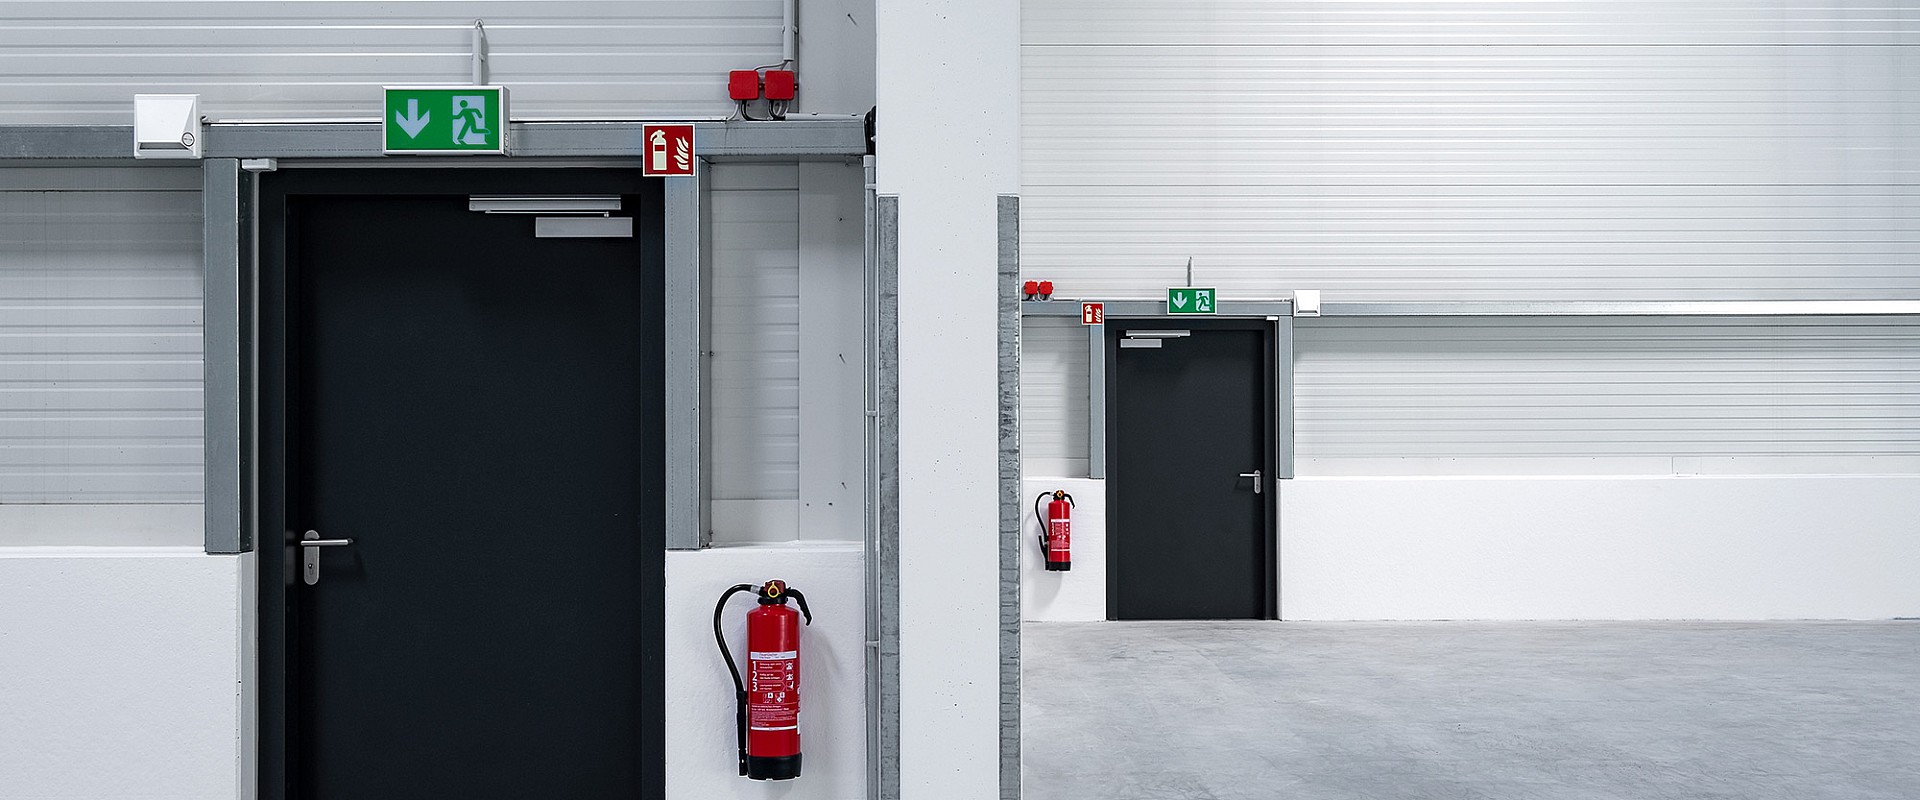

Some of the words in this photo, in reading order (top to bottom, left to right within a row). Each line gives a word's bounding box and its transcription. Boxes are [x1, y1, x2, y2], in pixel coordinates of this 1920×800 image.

[752, 661, 756, 670] 1
[752, 671, 758, 681] 2
[752, 682, 758, 692] 3
